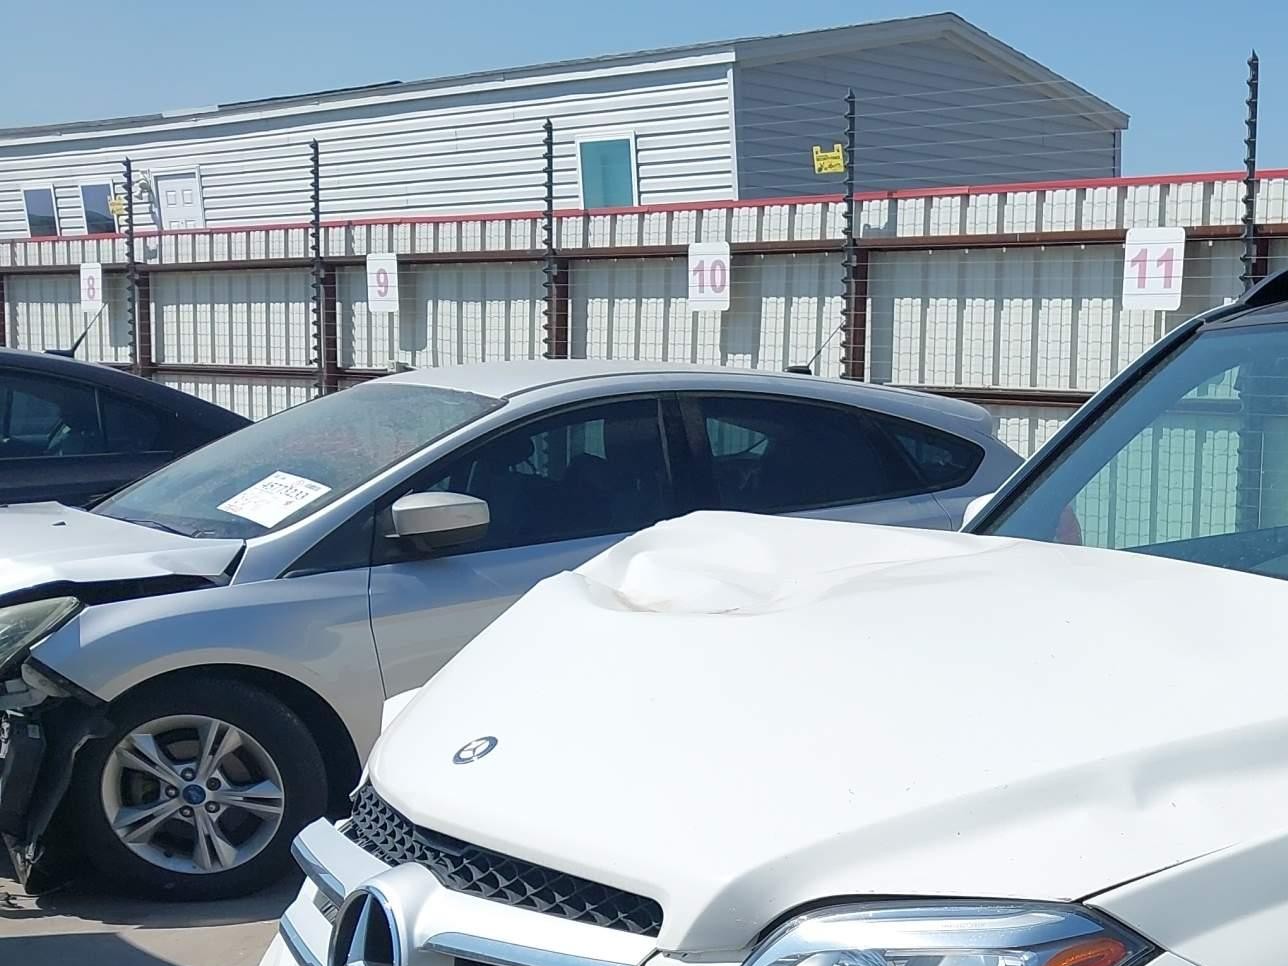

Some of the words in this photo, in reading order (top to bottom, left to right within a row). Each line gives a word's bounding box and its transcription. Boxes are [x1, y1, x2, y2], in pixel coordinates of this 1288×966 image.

[376, 268, 388, 297] 9
[693, 260, 726, 294] 10
[1130, 248, 1174, 288] 11
[87, 276, 96, 299] 8
